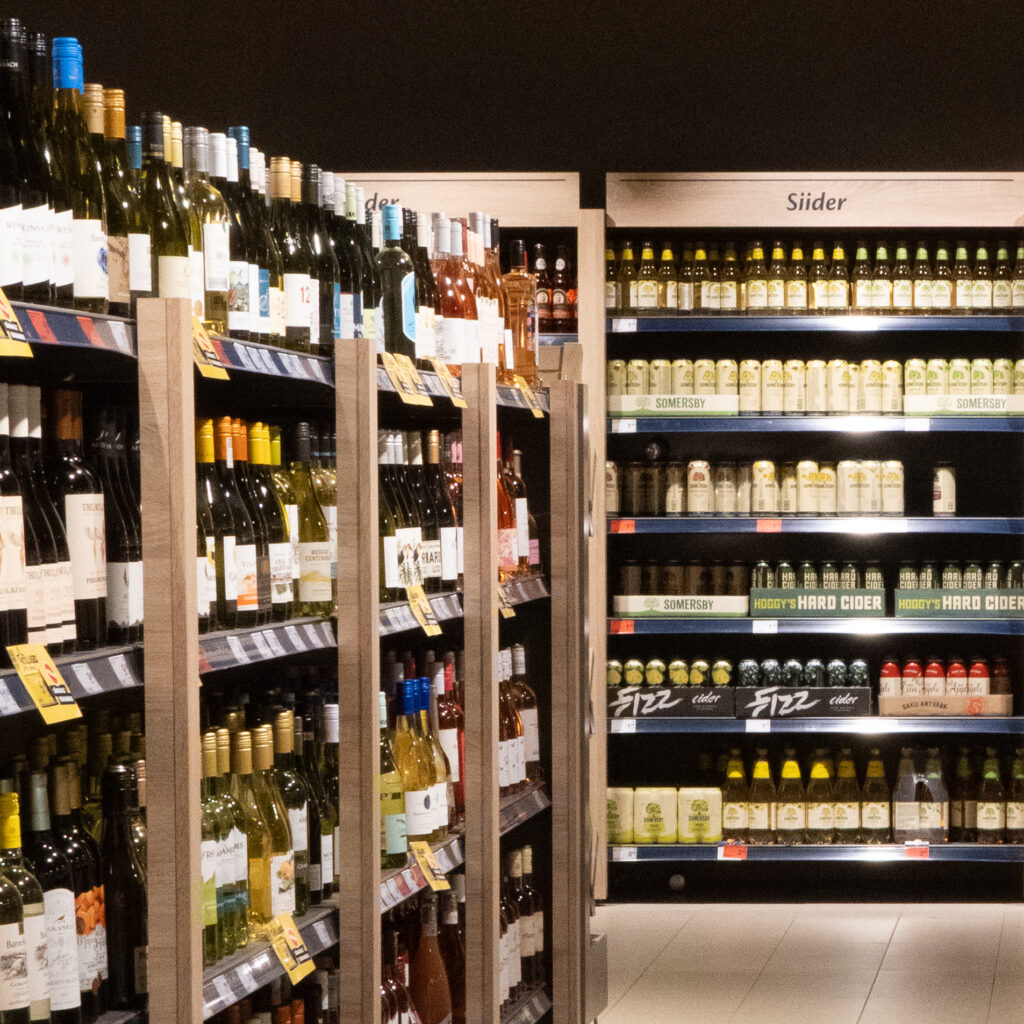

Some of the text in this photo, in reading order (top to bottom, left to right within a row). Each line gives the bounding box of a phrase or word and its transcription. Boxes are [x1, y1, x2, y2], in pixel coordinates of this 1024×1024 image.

[786, 192, 847, 211] Siider
[300, 286, 311, 304] 12
[655, 397, 706, 409] SOMERSBY
[956, 397, 1007, 409] SOMERSBY
[663, 599, 714, 611] SOMERSBY
[797, 595, 837, 610] HARD
[840, 595, 882, 610] CIDER
[942, 595, 981, 610] HARD
[608, 686, 723, 717] FIZZ cider
[744, 686, 859, 718] FIZZ cider
[902, 700, 919, 710] SAKU
